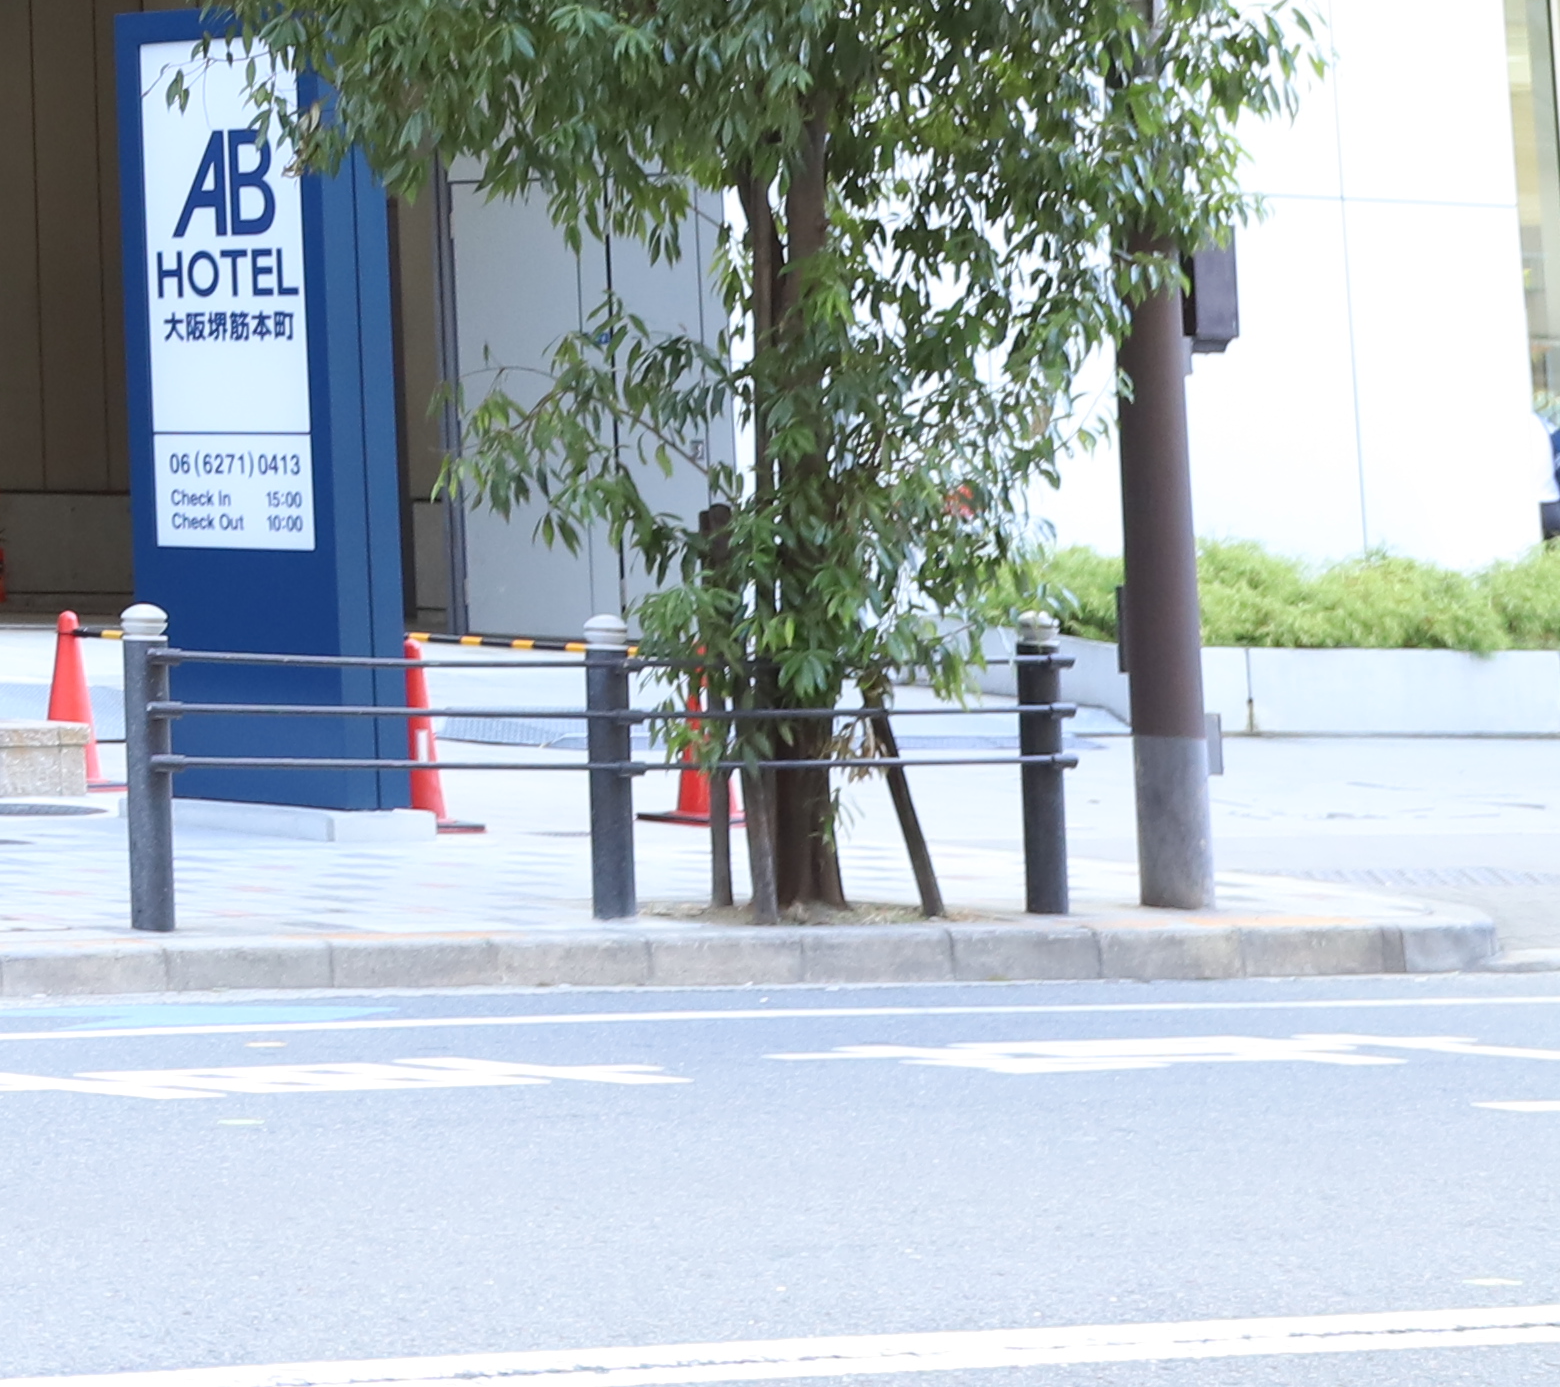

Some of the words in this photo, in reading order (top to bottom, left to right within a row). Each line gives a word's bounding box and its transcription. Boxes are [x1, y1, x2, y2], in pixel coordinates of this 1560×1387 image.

[172, 128, 276, 238] AB
[156, 248, 300, 299] HOTEL
[163, 310, 294, 342] 大阪堺筋本町
[169, 450, 301, 478] 06(6271)0413
[170, 488, 214, 507] Check
[218, 489, 231, 507] In
[266, 491, 303, 508] 15:00
[171, 512, 215, 531] Check
[219, 513, 245, 531] Out
[266, 514, 304, 532] 10:00
